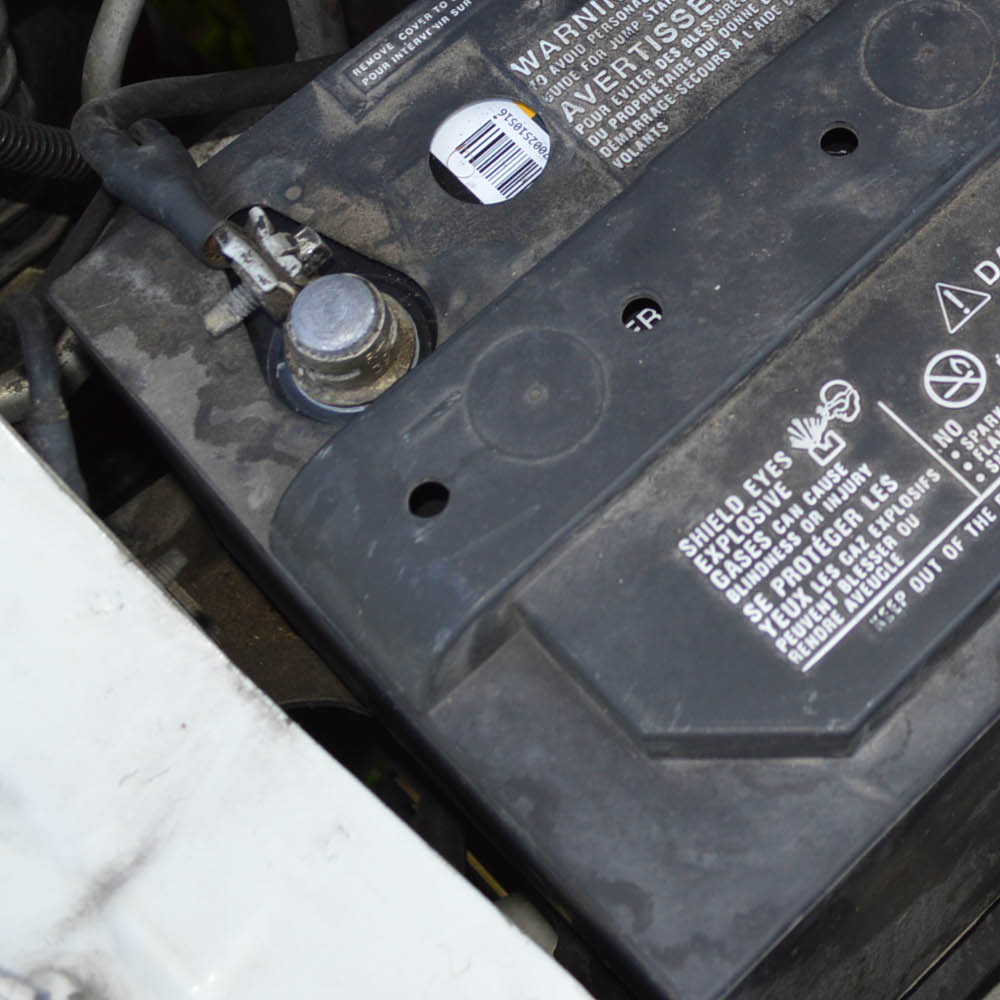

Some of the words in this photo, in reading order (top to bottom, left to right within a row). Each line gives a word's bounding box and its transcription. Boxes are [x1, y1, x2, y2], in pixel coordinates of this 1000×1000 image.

[351, 41, 394, 77] REMOVE
[432, 0, 448, 14] TO
[361, 60, 391, 86] POUR
[542, 69, 581, 103] GUIDE
[579, 48, 608, 72] FOR
[607, 19, 641, 50] JUMP
[547, 42, 587, 76] AVOID
[586, 126, 609, 146] DU
[606, 54, 695, 131] PROPRIÉTAIRE
[693, 36, 719, 59] QUI
[717, 2, 759, 39] DONNE
[597, 42, 731, 159] DÉMARRAGE-SECOURS
[741, 3, 782, 40] L'AIDE
[573, 103, 611, 135] POUR
[654, 46, 682, 70] DES
[611, 119, 669, 170] VOLANTS
[932, 418, 964, 448] NO
[676, 493, 746, 558] SHIELD
[741, 449, 794, 498] EYES
[692, 480, 793, 575] EXPLOSIVE
[708, 529, 773, 590] GASES
[770, 502, 805, 535] CAN
[801, 461, 849, 506] CAUSE
[724, 530, 802, 605] BLINDNESS
[799, 509, 825, 534] OR
[821, 462, 873, 512] INJURY
[741, 591, 774, 624] SE
[766, 504, 864, 598] PROTÉGER
[859, 472, 899, 511] LES
[757, 586, 814, 639] YEUX
[809, 562, 841, 594] LES
[837, 534, 871, 567] GAZ
[866, 467, 941, 538] EXPLOSIFS
[907, 557, 943, 594] OUT
[940, 534, 966, 561] OF
[963, 505, 997, 538] THE
[774, 590, 839, 653] PEUVENT
[835, 533, 898, 594] BLESSER
[895, 512, 921, 537] OU
[787, 609, 845, 665] RENDRE
[842, 551, 905, 613] AVEUGLE
